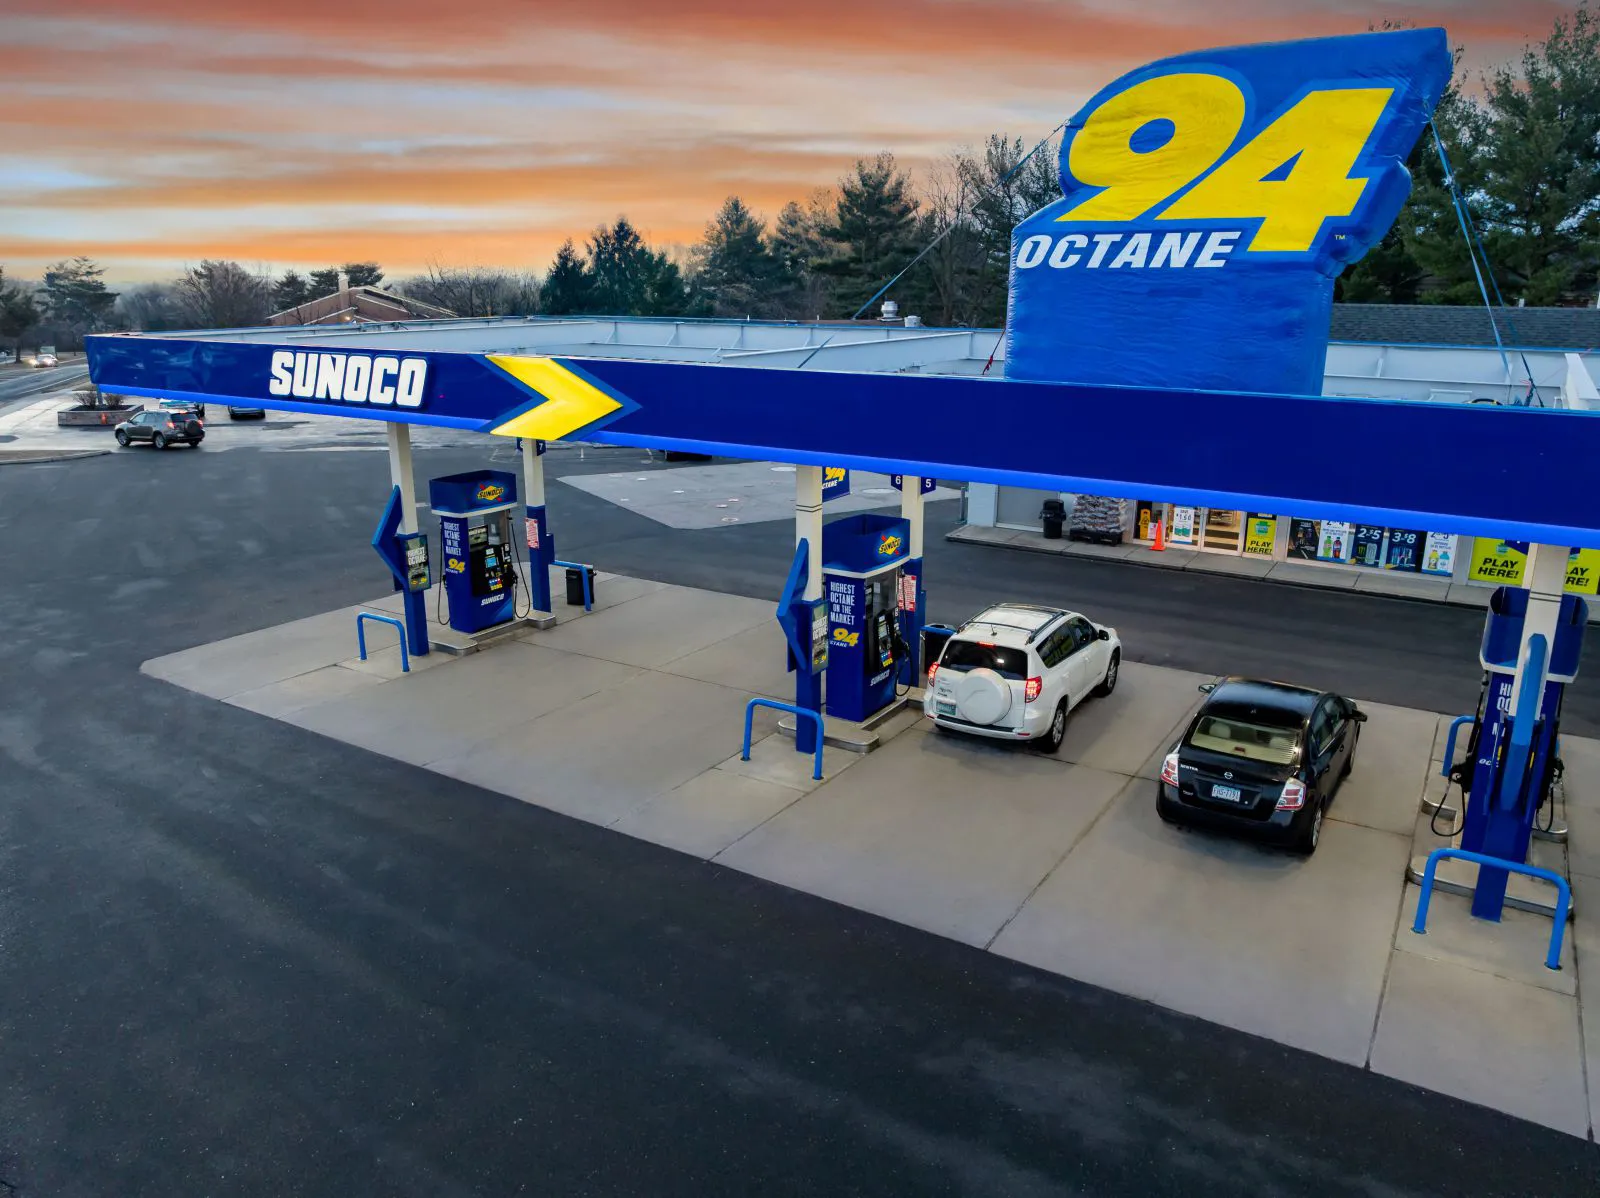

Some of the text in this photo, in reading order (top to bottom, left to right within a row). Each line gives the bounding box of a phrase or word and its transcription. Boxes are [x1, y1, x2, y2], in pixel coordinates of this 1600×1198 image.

[1054, 73, 1394, 251] 94
[1016, 231, 1241, 270] OCTANE
[269, 351, 427, 407] SUNOCO
[538, 442, 544, 450] 7
[821, 479, 838, 490] CTANE
[895, 475, 902, 485] 6
[925, 478, 932, 488] 5
[478, 487, 503, 498] SUNOCO
[448, 558, 466, 574] 94
[1483, 558, 1518, 568] PLAY
[1478, 567, 1519, 578] HERE!
[1565, 566, 1589, 577] AY
[1564, 576, 1590, 587] RE!
[830, 581, 856, 595] HIGHEST
[481, 593, 504, 605] SUNOCO
[830, 591, 856, 606] OCTANE
[832, 603, 852, 615] ON THE
[830, 611, 856, 626] MARKET
[833, 627, 860, 647] 94
